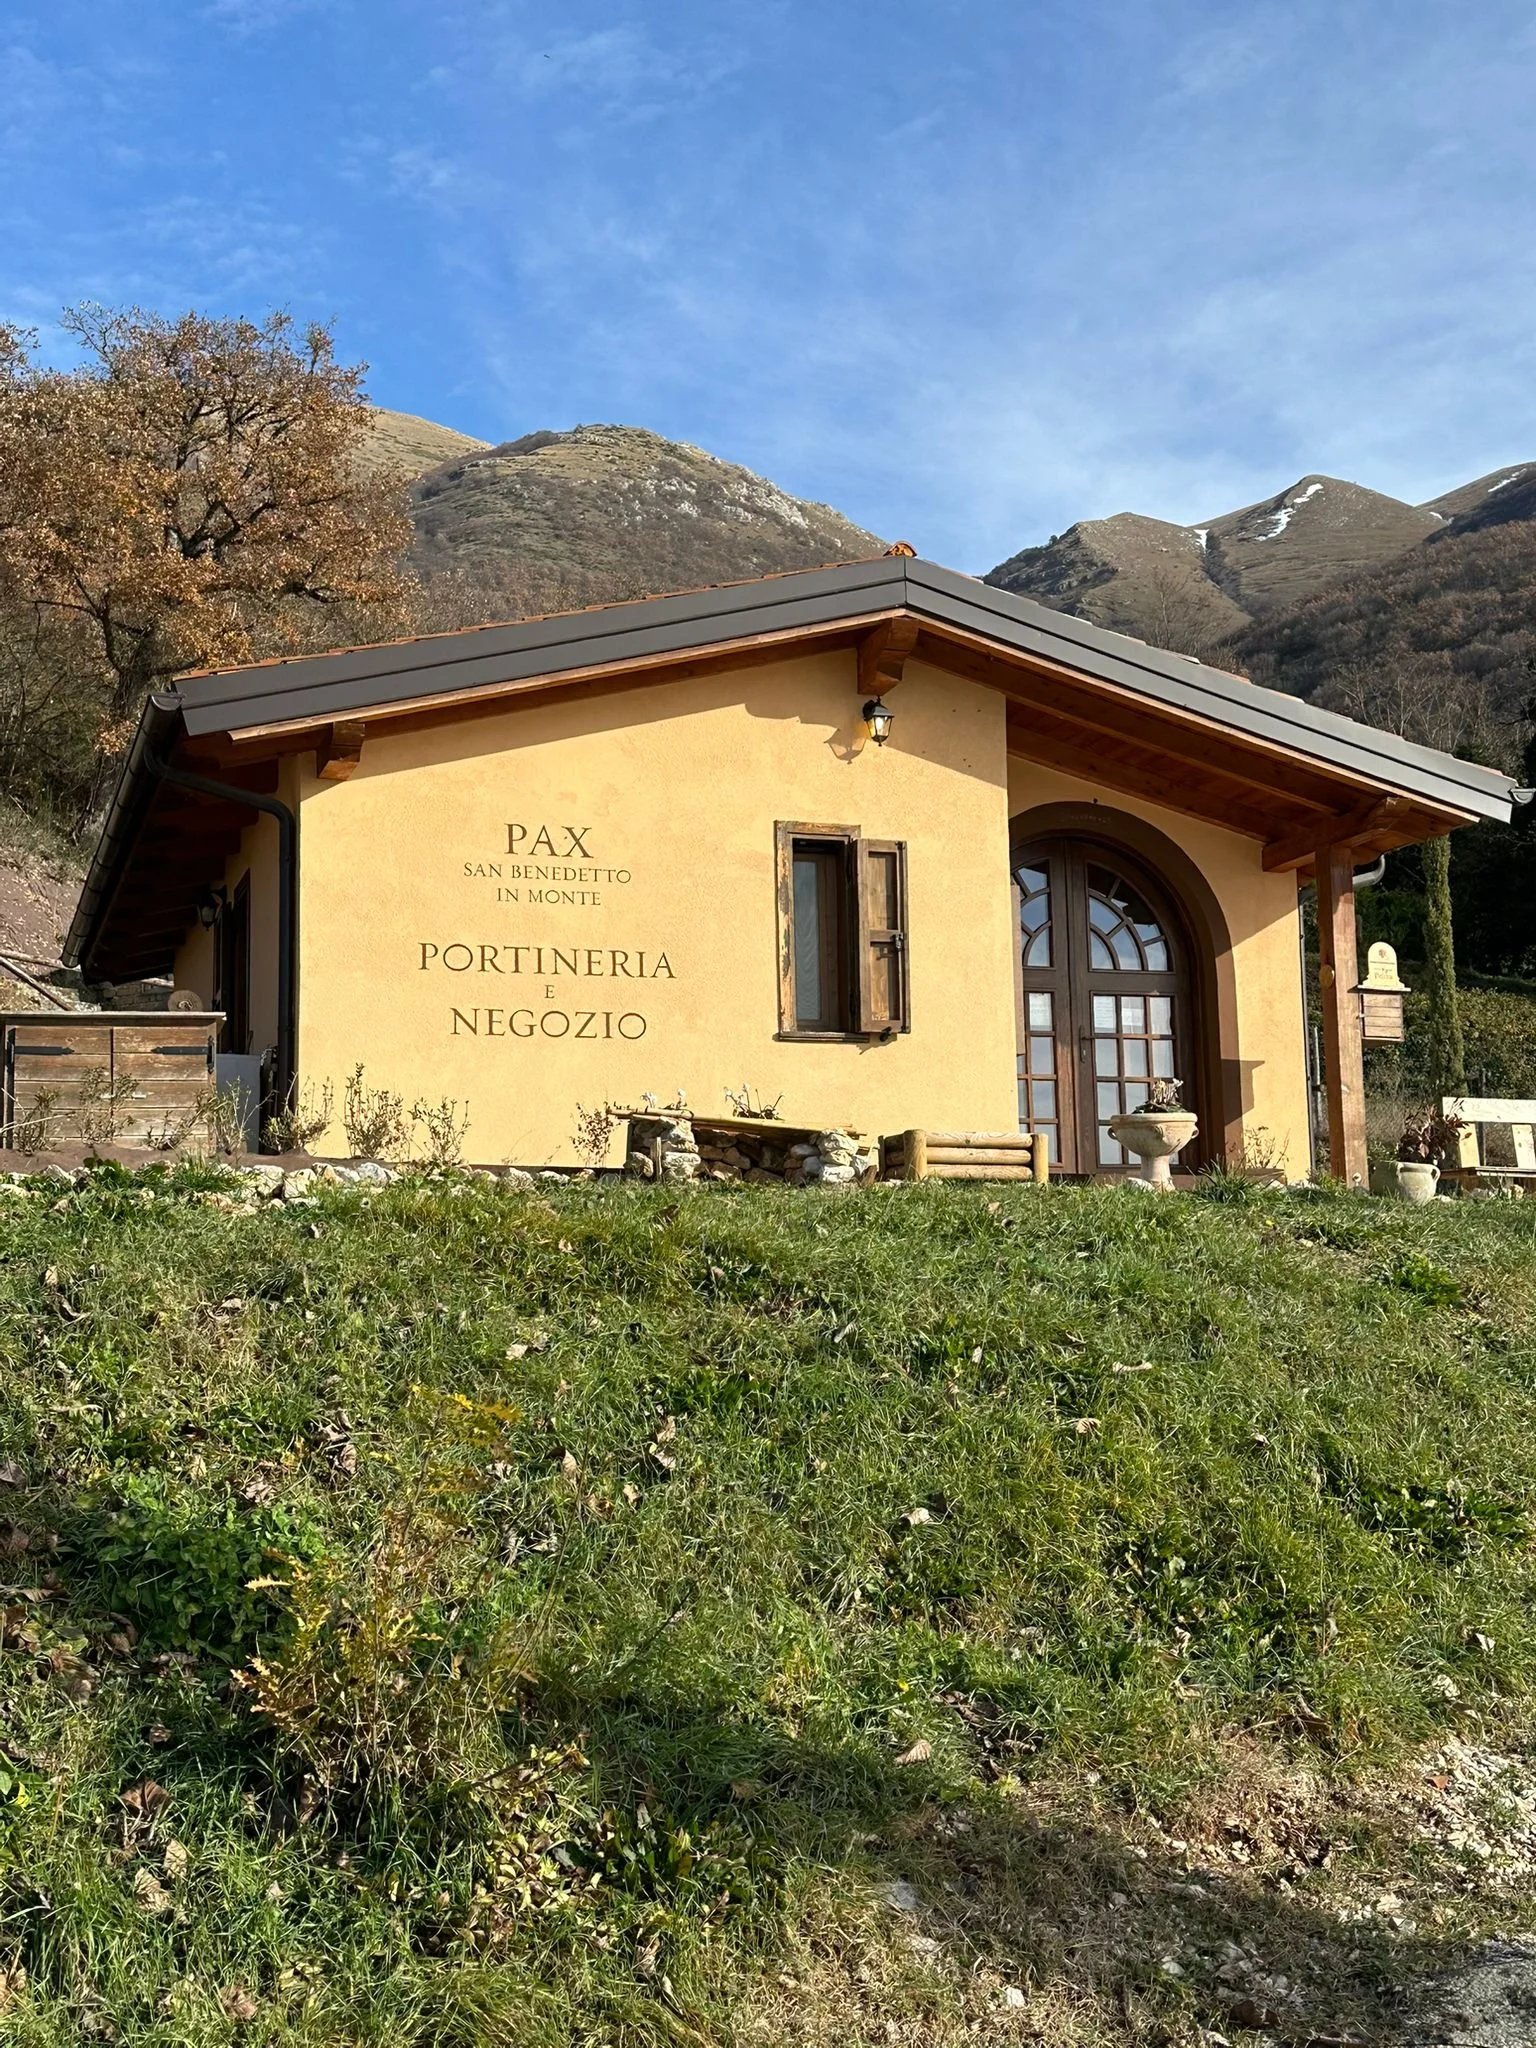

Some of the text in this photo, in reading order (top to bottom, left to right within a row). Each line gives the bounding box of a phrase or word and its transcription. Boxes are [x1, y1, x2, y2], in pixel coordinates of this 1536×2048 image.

[504, 823, 594, 858] PAX
[464, 862, 632, 884] SAN BENEDETTO
[497, 888, 601, 906] IN MONTE
[418, 942, 677, 979] PORTINERIA
[544, 984, 555, 999] E
[450, 1007, 647, 1040] NEGOZIO
